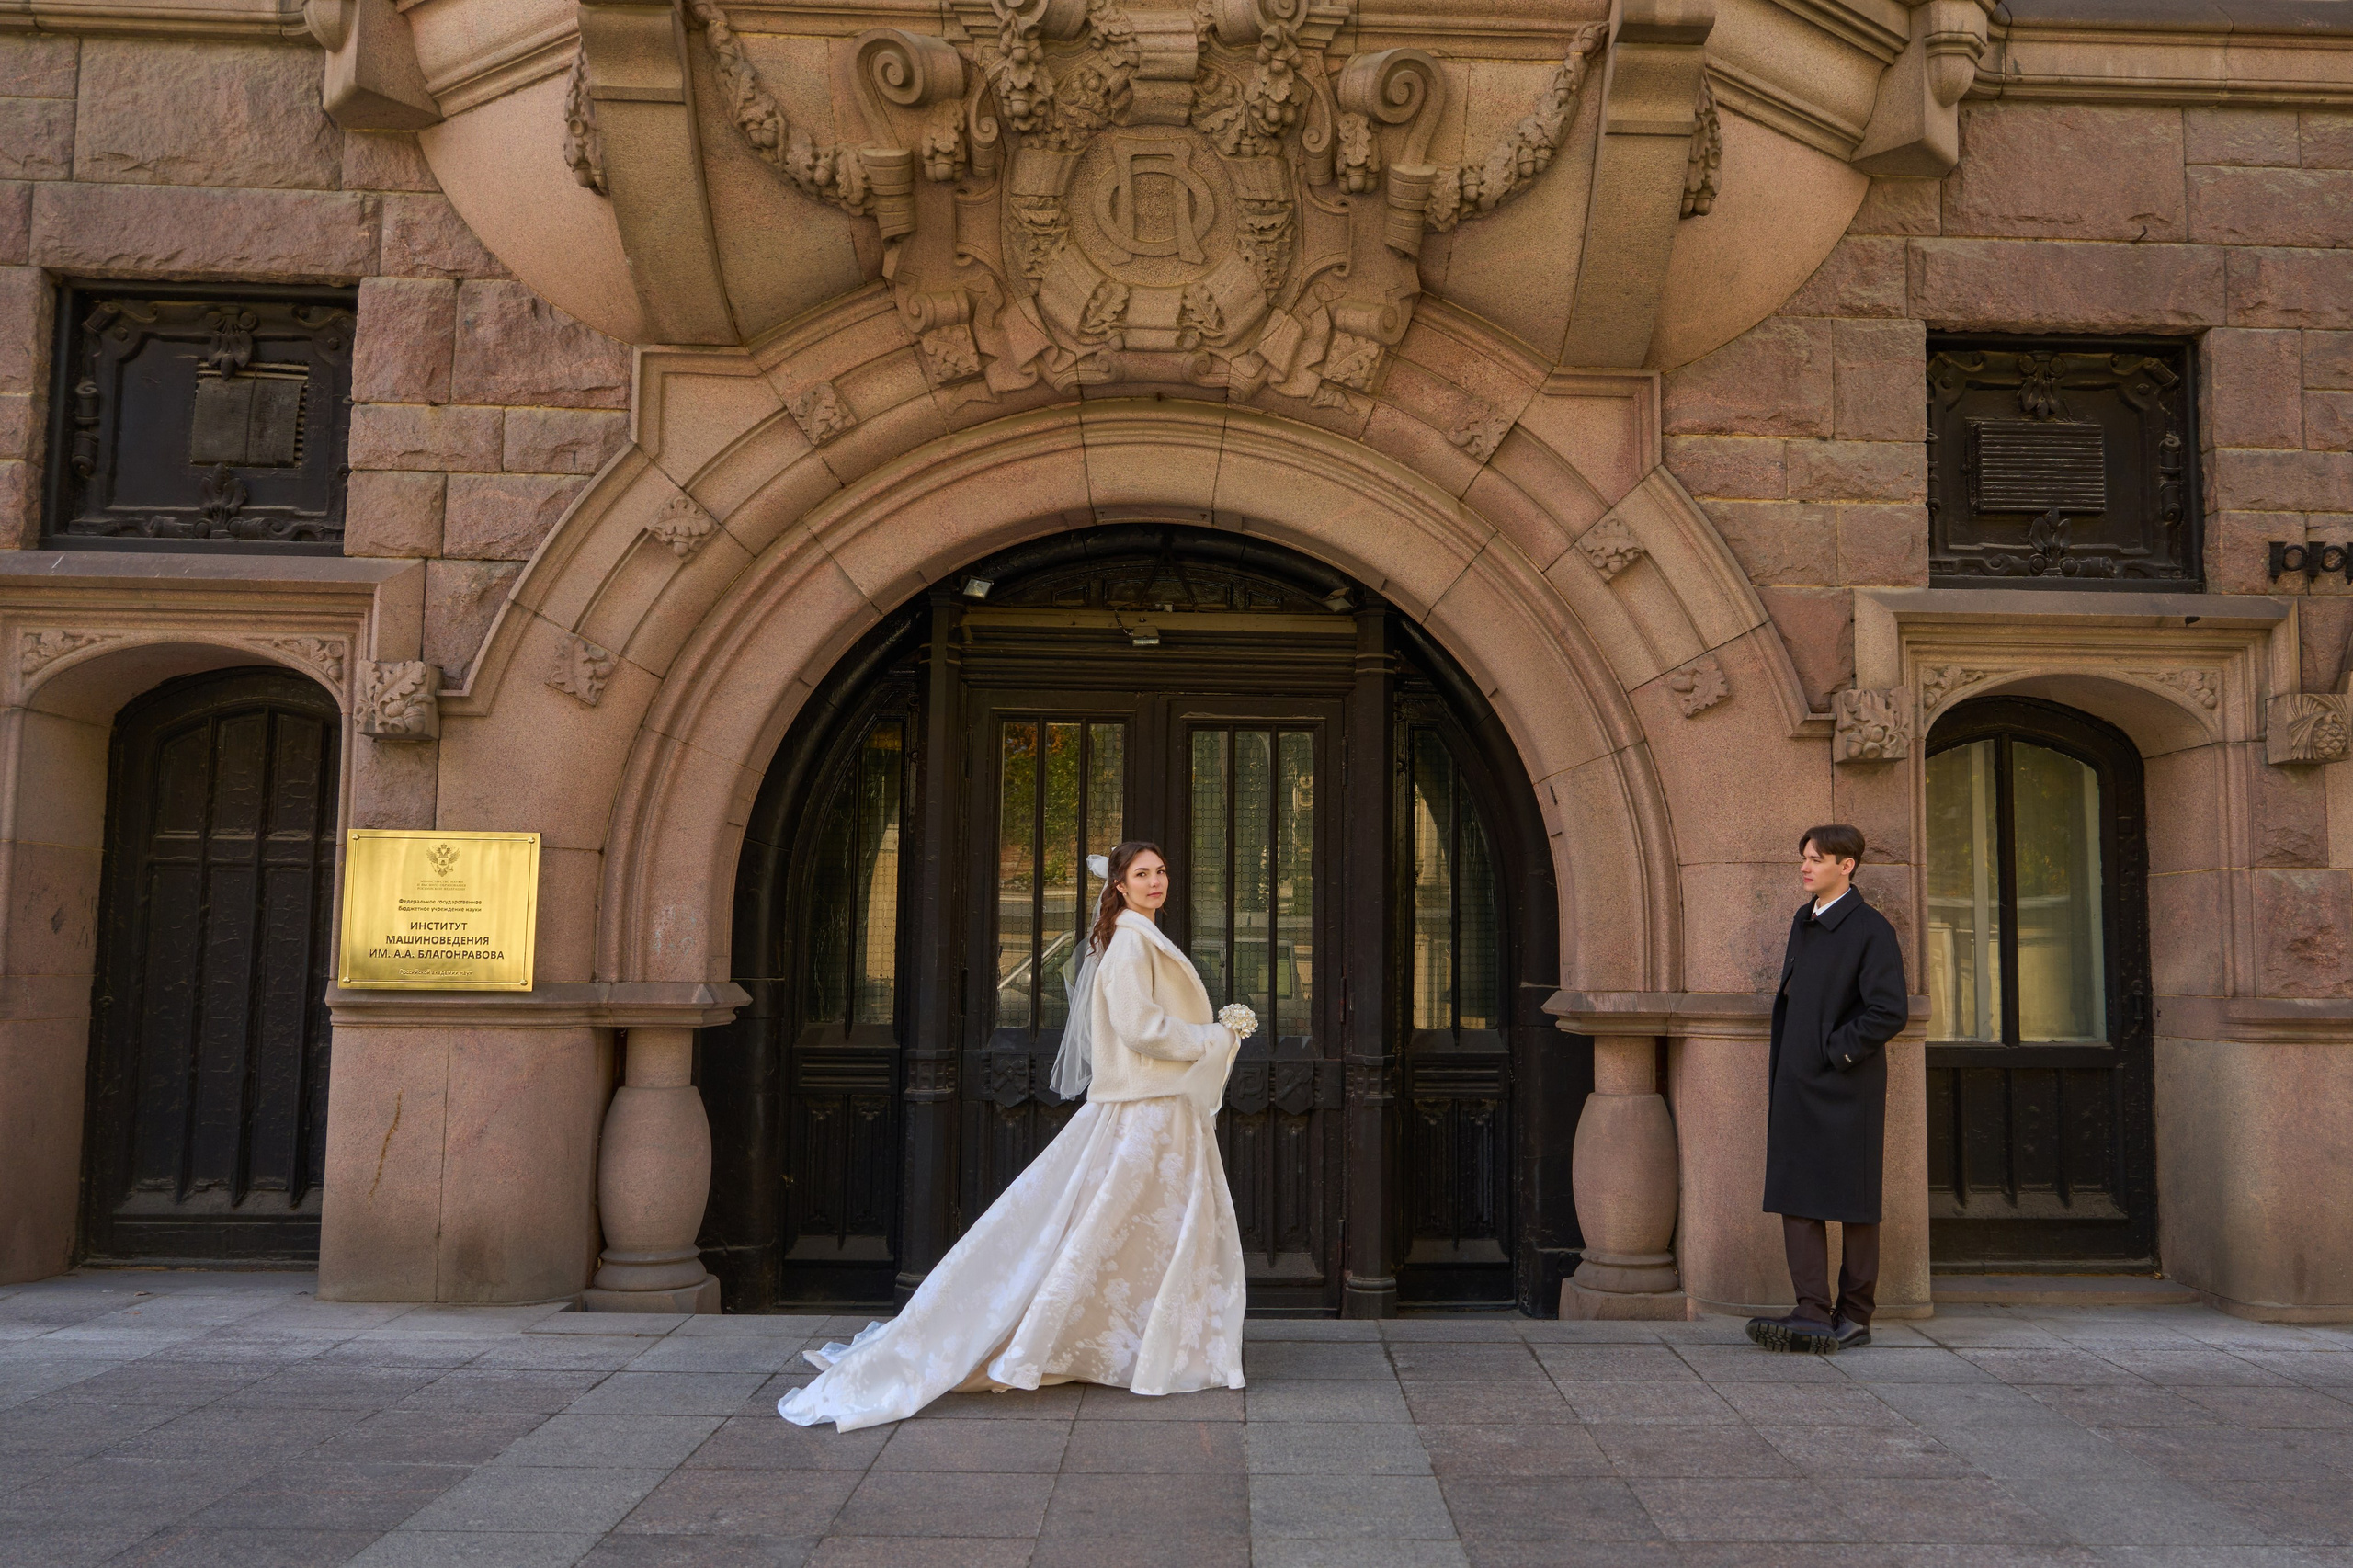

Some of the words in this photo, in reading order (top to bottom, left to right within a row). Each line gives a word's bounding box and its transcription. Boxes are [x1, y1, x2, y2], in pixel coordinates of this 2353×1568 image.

[410, 921, 468, 931] ИНСТИТУТ
[385, 935, 490, 947] МАШИНОВЕДЕНИЯ
[369, 949, 391, 959] ИМ.
[393, 949, 415, 959] А.А.
[418, 949, 505, 960] БЛАГОНРАВОВА
